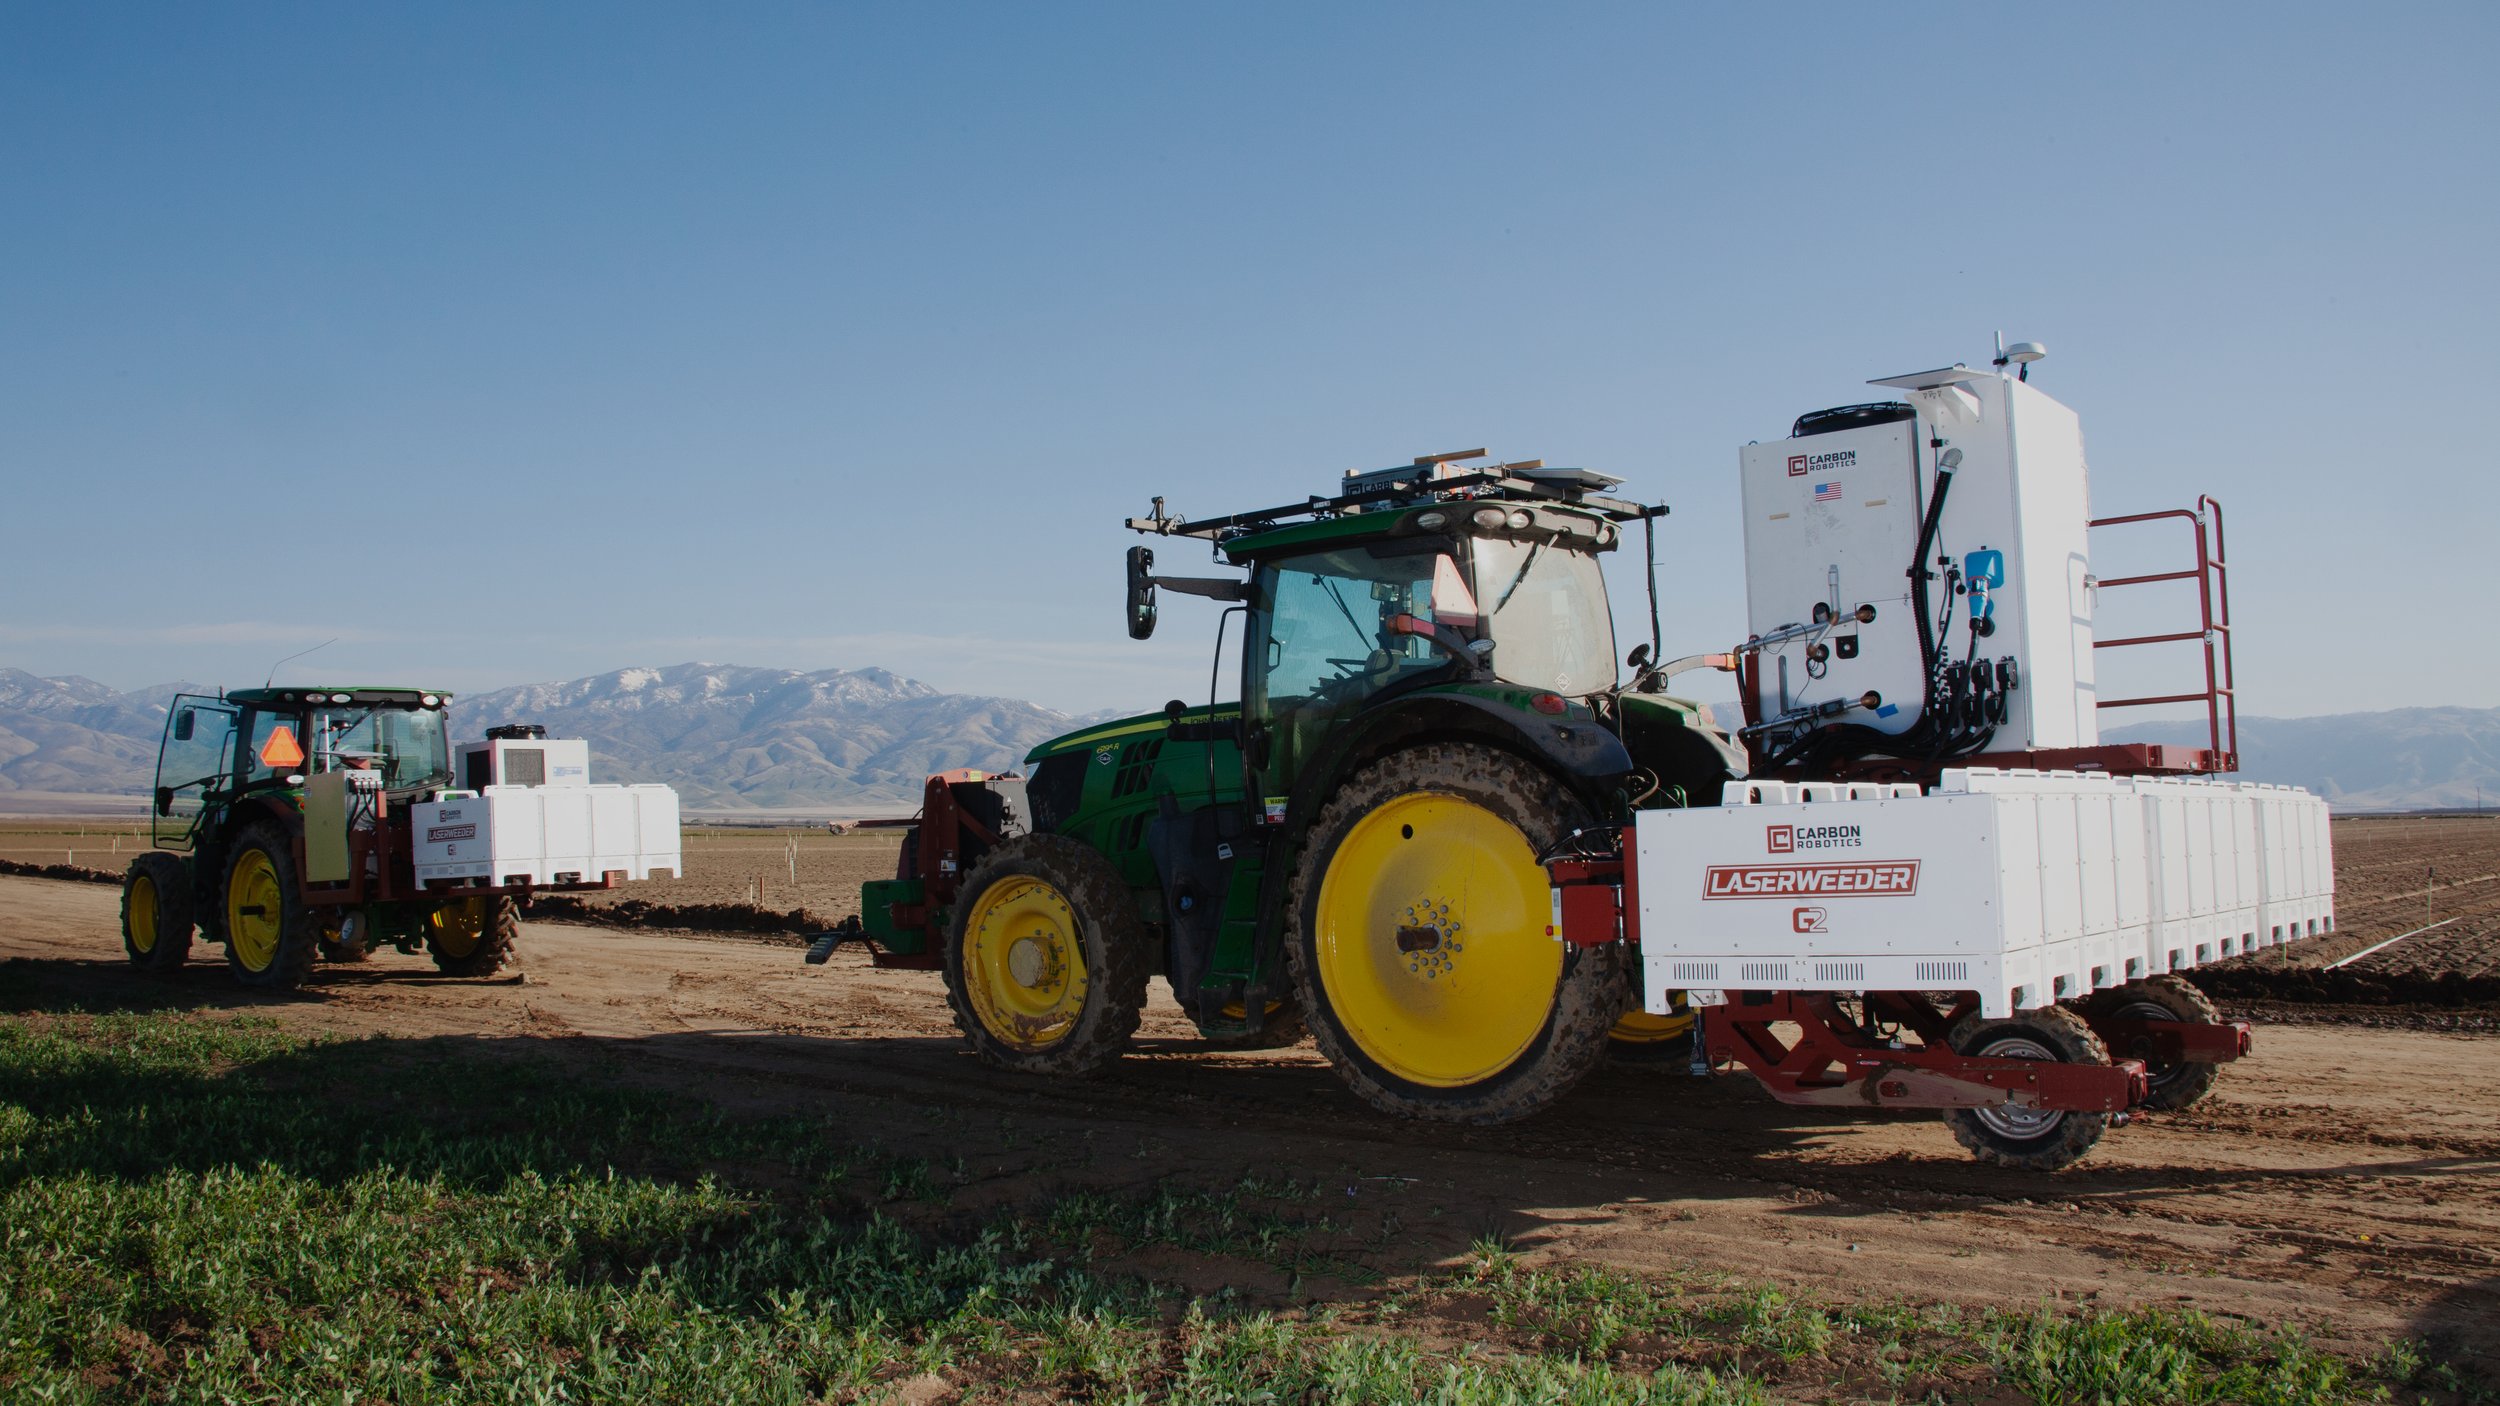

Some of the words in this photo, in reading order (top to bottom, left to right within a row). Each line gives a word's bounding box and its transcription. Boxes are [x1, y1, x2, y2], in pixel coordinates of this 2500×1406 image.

[1809, 450, 1856, 465] CARBON
[1809, 459, 1856, 472] ROBOTICS
[1796, 825, 1861, 839] CARBON
[1797, 838, 1862, 849] ROBOTICS
[1710, 867, 1911, 893] LASERWEEDER
[1792, 906, 1829, 934] G2
